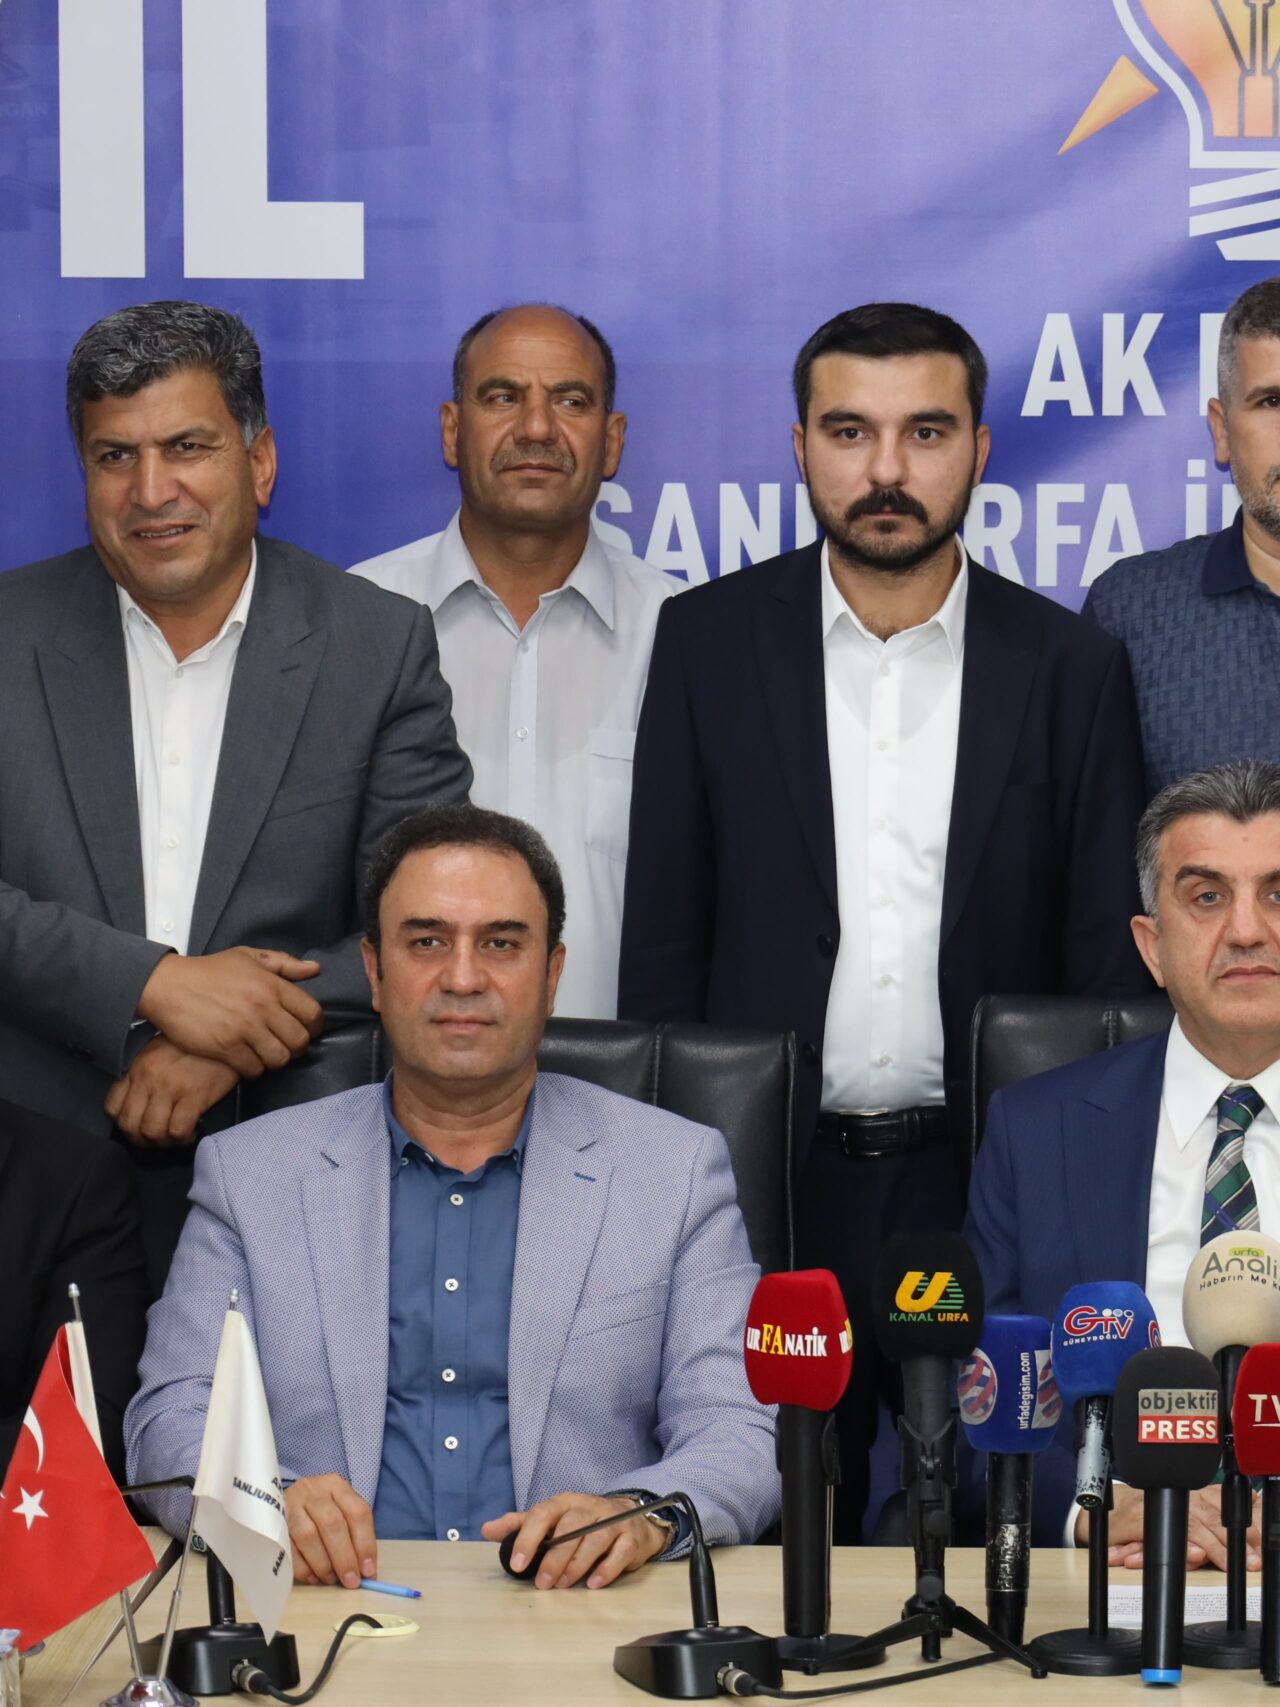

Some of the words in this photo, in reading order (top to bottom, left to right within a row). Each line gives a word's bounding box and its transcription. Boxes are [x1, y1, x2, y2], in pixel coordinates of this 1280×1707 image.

[1020, 312, 1167, 417] AK
[1233, 1247, 1260, 1257] urfa
[889, 1312, 934, 1322] KANAL
[937, 1312, 969, 1322] URFA
[1017, 1352, 1035, 1430] urfadegisim.com
[1140, 1391, 1217, 1414] objektif
[1141, 1420, 1217, 1440] PRESS
